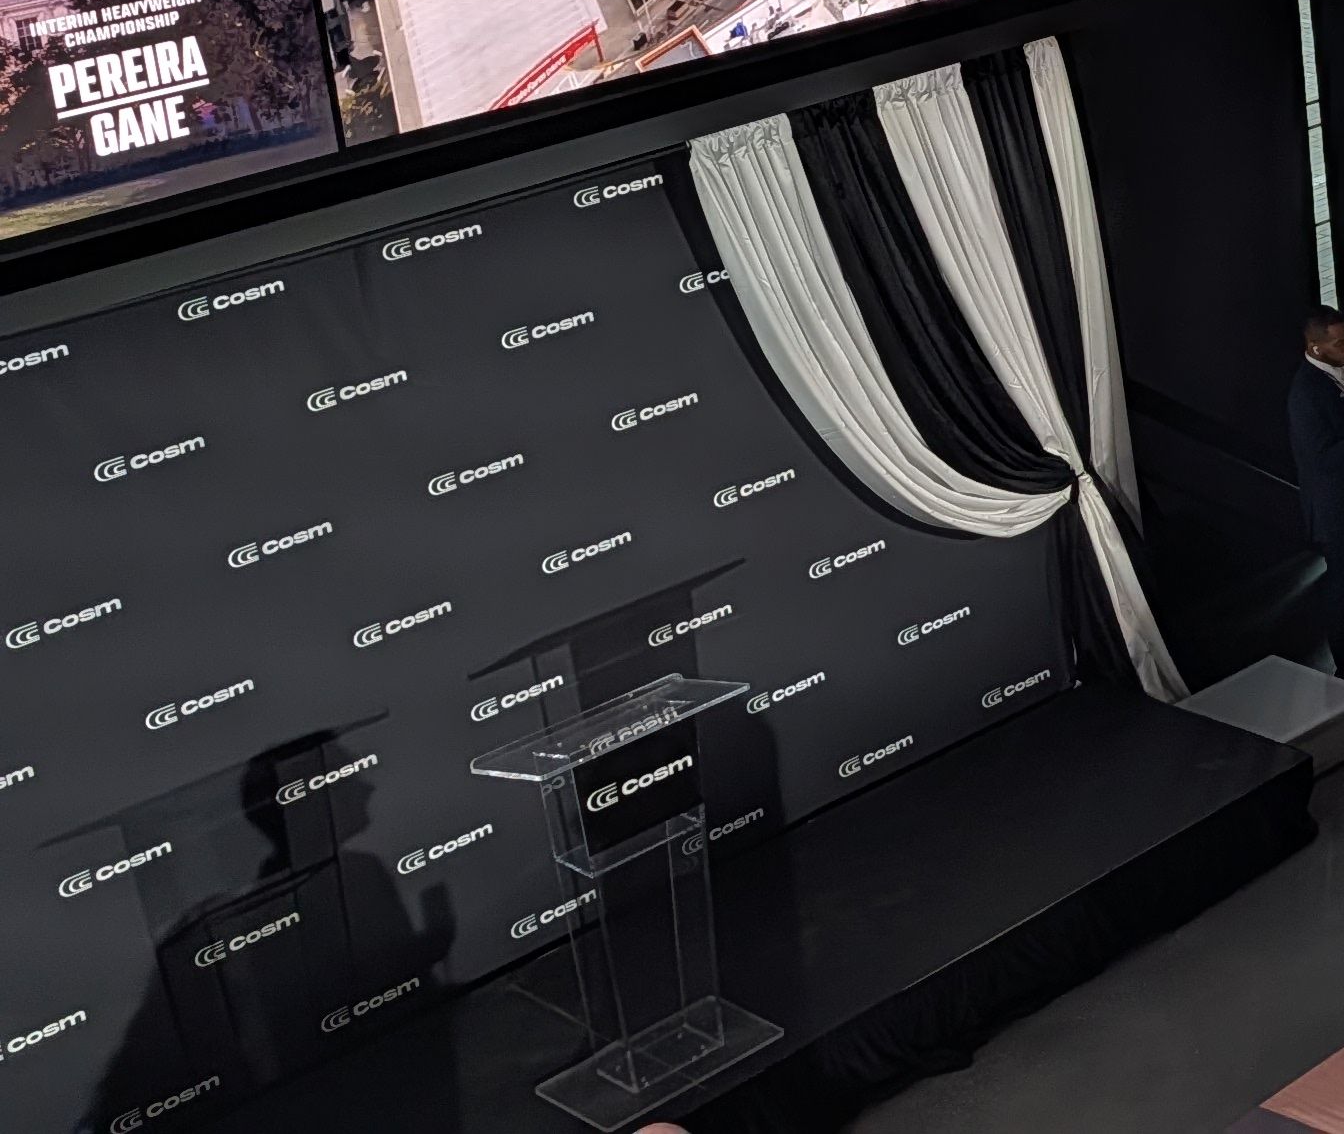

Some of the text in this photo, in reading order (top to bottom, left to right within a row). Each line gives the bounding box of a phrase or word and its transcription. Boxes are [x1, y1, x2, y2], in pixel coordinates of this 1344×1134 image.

[29, 10, 98, 37] INTERIM
[64, 11, 180, 48] CHAMPIONSHIP
[48, 35, 207, 109] PEREIRA
[90, 95, 190, 157] GANE
[602, 174, 664, 199] cosm
[414, 224, 483, 251] cosm
[212, 280, 285, 310] cosm
[531, 311, 595, 339] cosm
[339, 370, 408, 401] cosm
[639, 392, 699, 421] cosm
[129, 436, 206, 470] cosm
[459, 453, 524, 484] cosm
[739, 468, 796, 498] cosm
[261, 521, 333, 555] cosm
[570, 531, 632, 562] cosm
[833, 539, 886, 568] cosm
[43, 598, 122, 635] cosm
[385, 601, 452, 635] cosm
[675, 604, 733, 635] cosm
[920, 606, 971, 635] cosm
[180, 679, 255, 716] cosm
[500, 675, 564, 709] cosm
[771, 671, 826, 702] cosm
[1003, 669, 1051, 697] cosm
[862, 735, 914, 766] cosm
[308, 753, 378, 790] cosm
[621, 755, 693, 796] cosm
[428, 823, 493, 860] cosm
[95, 841, 172, 882] cosm
[539, 889, 597, 924] cosm
[228, 912, 300, 952] cosm
[6, 1010, 87, 1053] cosm
